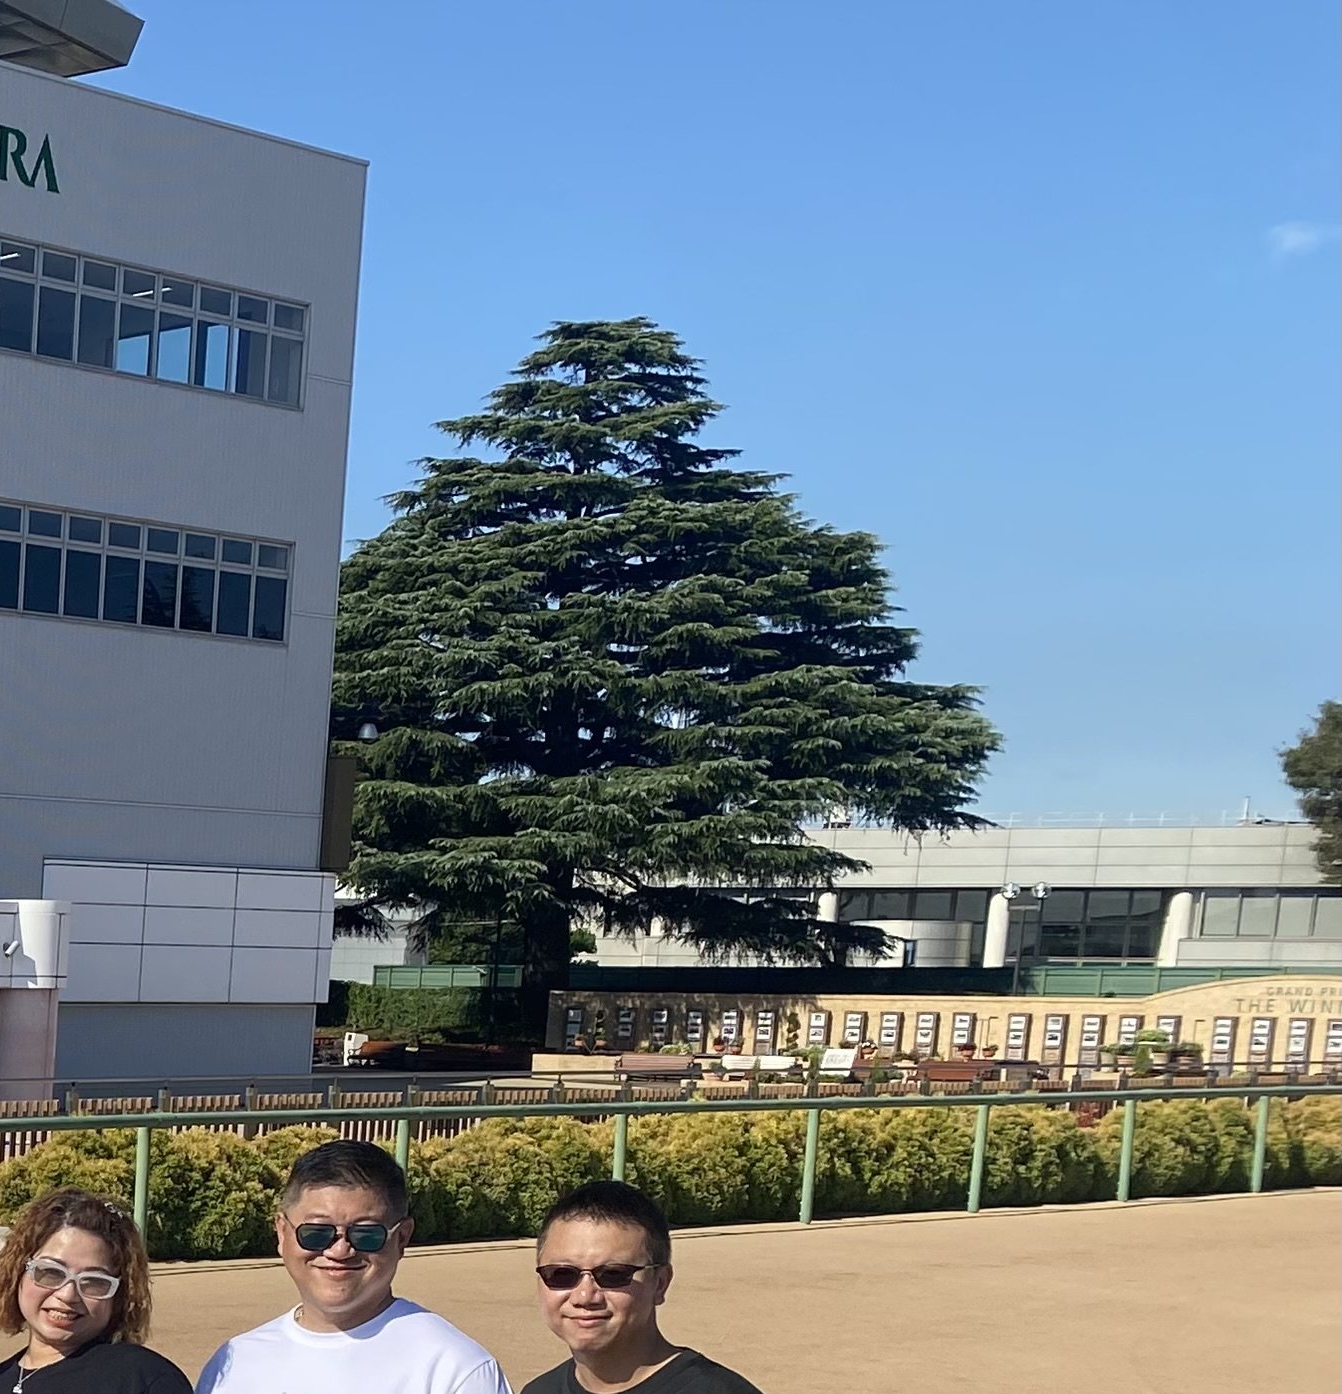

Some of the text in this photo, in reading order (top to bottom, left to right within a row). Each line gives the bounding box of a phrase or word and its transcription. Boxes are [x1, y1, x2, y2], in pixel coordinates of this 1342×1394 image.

[1266, 986, 1313, 997] GRAND
[1236, 998, 1342, 1014] THE WIN
